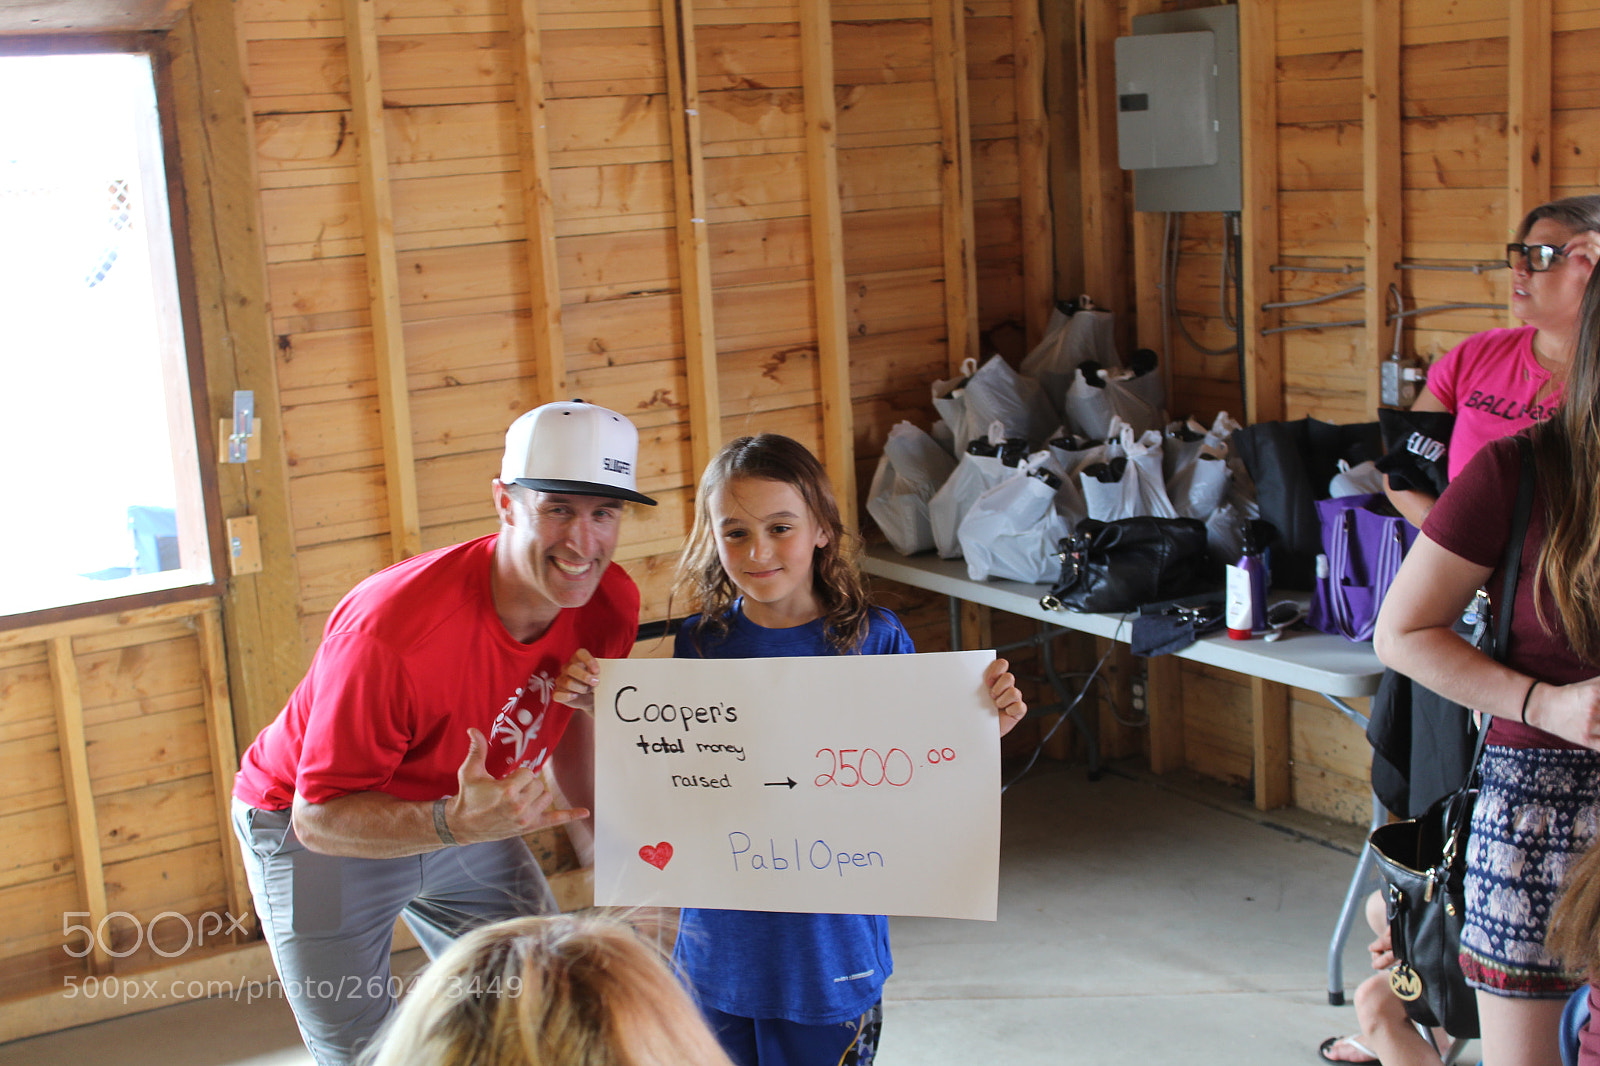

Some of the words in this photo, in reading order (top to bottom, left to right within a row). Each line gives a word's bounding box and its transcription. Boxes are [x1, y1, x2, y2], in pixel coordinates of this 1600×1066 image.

[614, 685, 738, 732] Cooper's
[636, 734, 686, 754] total
[695, 742, 747, 762] money
[671, 773, 733, 789] raised
